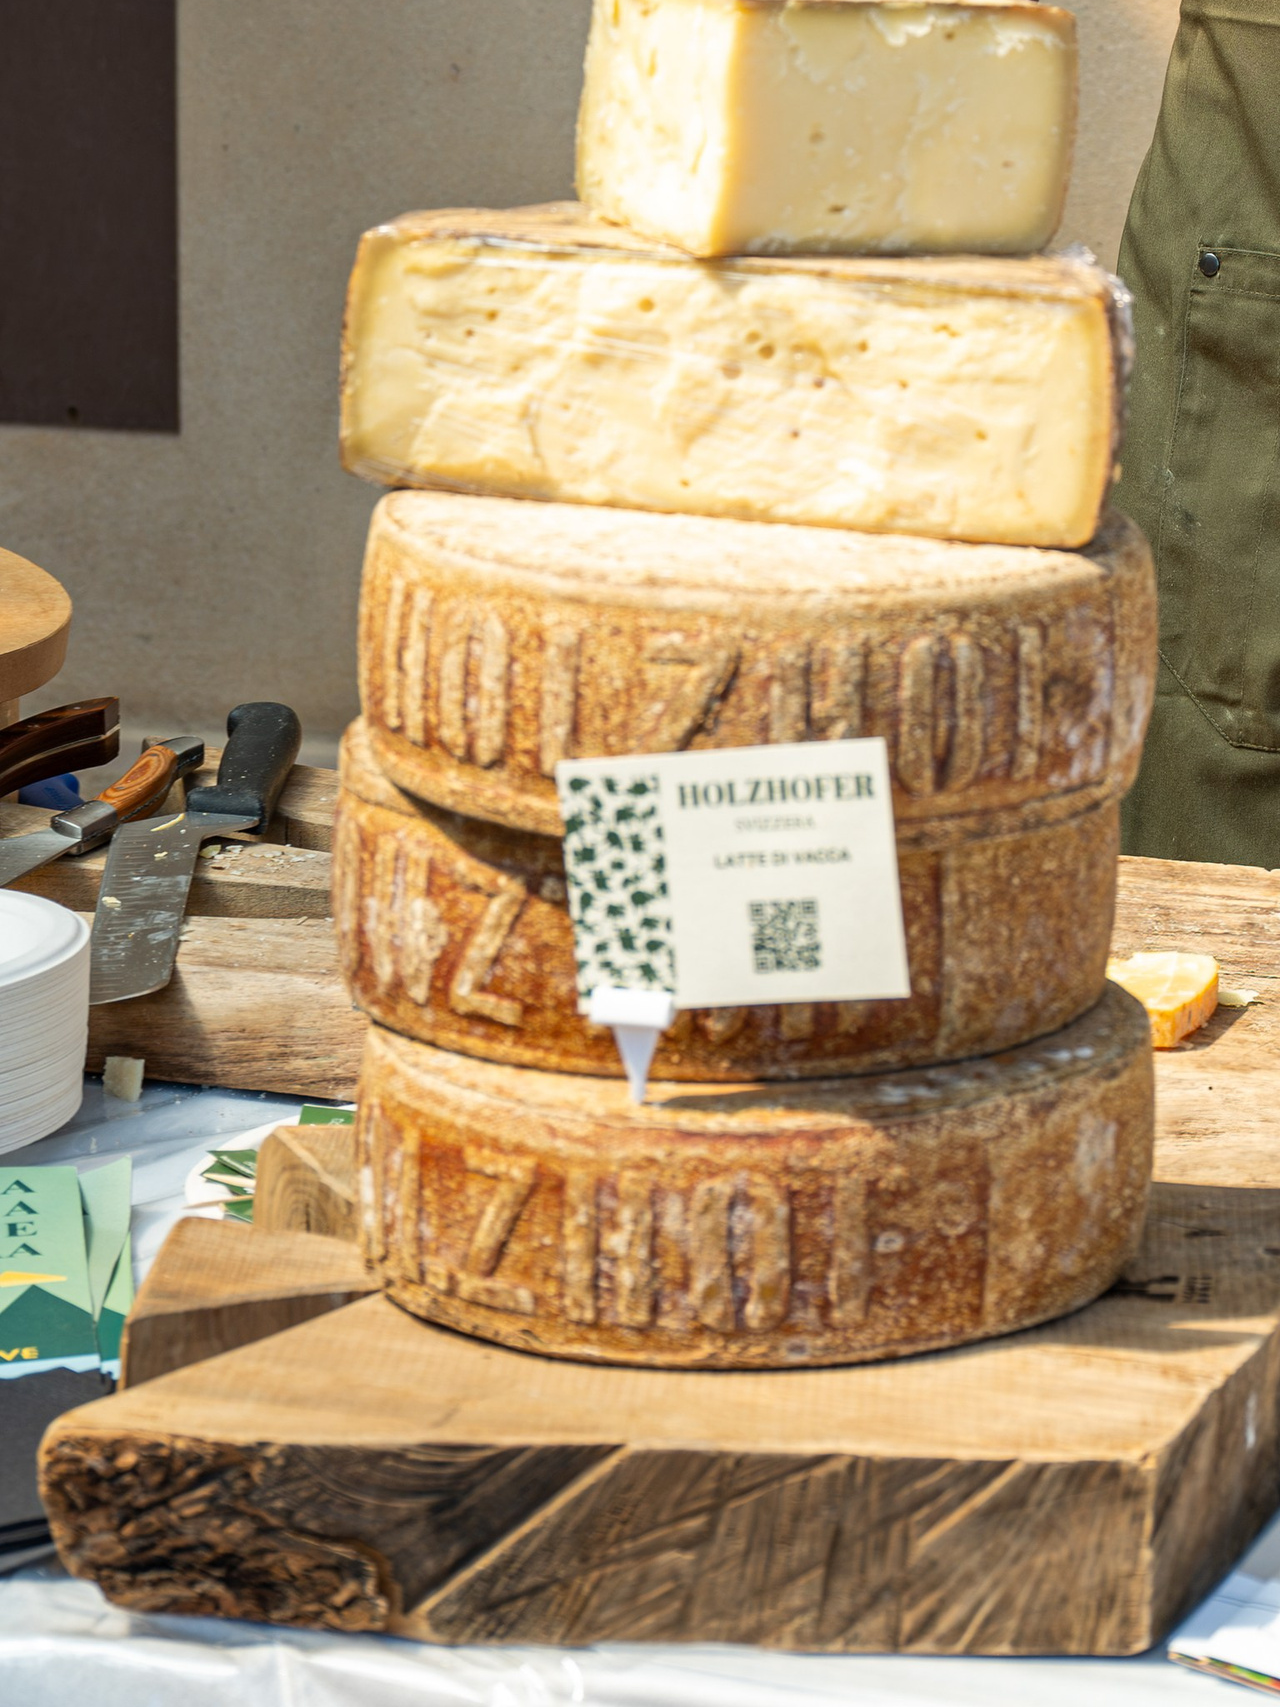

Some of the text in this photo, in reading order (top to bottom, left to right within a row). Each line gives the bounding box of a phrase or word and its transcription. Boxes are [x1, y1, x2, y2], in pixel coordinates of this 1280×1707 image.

[677, 772, 876, 810] HOLZHOFER
[713, 846, 853, 870] LATTE DI VACCA
